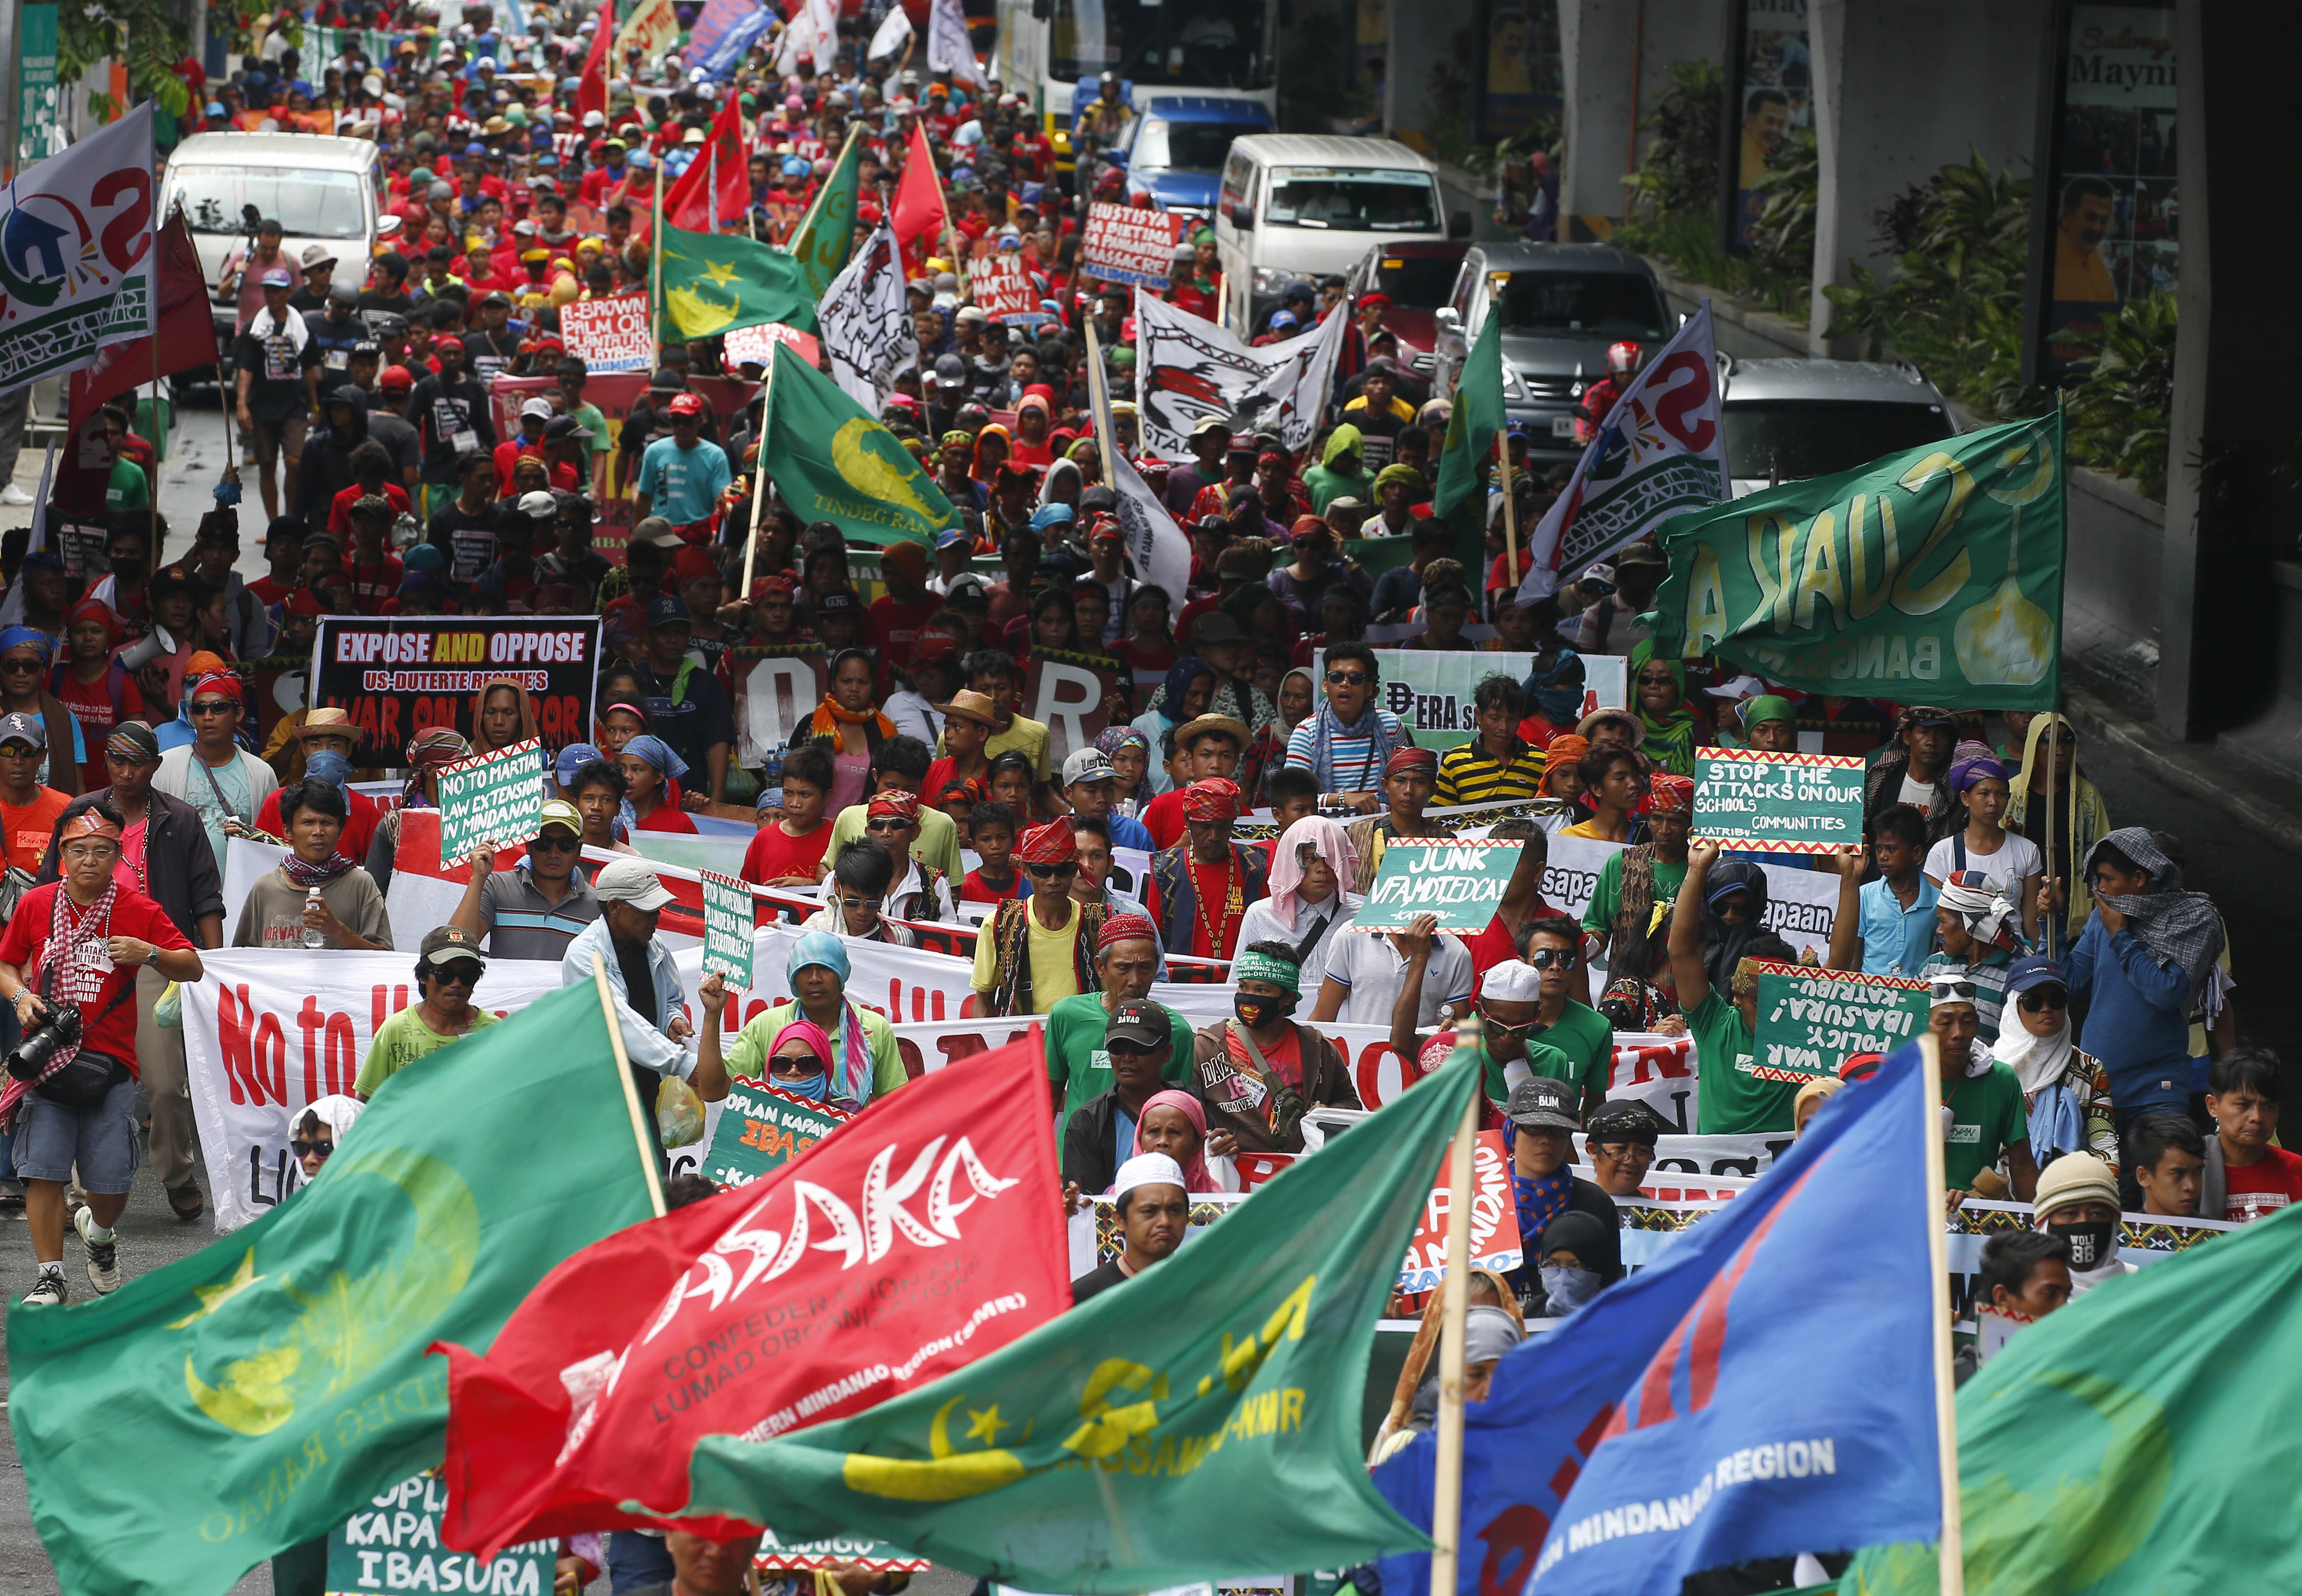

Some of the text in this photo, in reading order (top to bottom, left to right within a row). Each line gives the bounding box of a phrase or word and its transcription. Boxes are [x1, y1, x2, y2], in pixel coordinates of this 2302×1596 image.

[1086, 218, 1104, 232] SA
[1089, 202, 1170, 228] HUSTISYA
[968, 254, 1021, 278] NO TO
[973, 274, 1032, 297] MARTIAL
[562, 319, 613, 337] PALM
[814, 494, 888, 524] TINDEG
[337, 632, 586, 662] EXPOSE AND OPPOSE
[364, 671, 470, 691] US-DUTERTE
[443, 752, 541, 799] NO TO MARTIAL
[1708, 763, 1831, 784] STOP THE
[442, 798, 470, 822] LAW
[472, 775, 542, 814] EXTENSION
[1694, 798, 1757, 813] SCHOOLS
[1695, 781, 1862, 803] ATTACKS ON OUR
[443, 795, 541, 841] IN MINDANAO
[1752, 816, 1846, 830] COMMUNITIES
[1409, 847, 1491, 874] JUNK
[703, 880, 752, 917] STOP IMPERIALIST
[738, 916, 753, 943] MORO
[708, 928, 751, 961] TERRITORIES!
[1117, 1016, 1140, 1024] DAVAO
[1769, 997, 1914, 1036] IBASURA!
[217, 982, 288, 1107] No
[1767, 1043, 1822, 1069] WAR
[725, 1093, 778, 1124] OPLAN
[1538, 1094, 1560, 1108] BUM
[2070, 1234, 2096, 1246] WOLF
[2072, 1245, 2095, 1264] 88
[652, 1351, 754, 1423] LUMAD
[799, 1363, 890, 1420] MINDANAO
[1568, 1438, 1836, 1553] MINDANAO REGION
[356, 1549, 541, 1595] IBASURA
